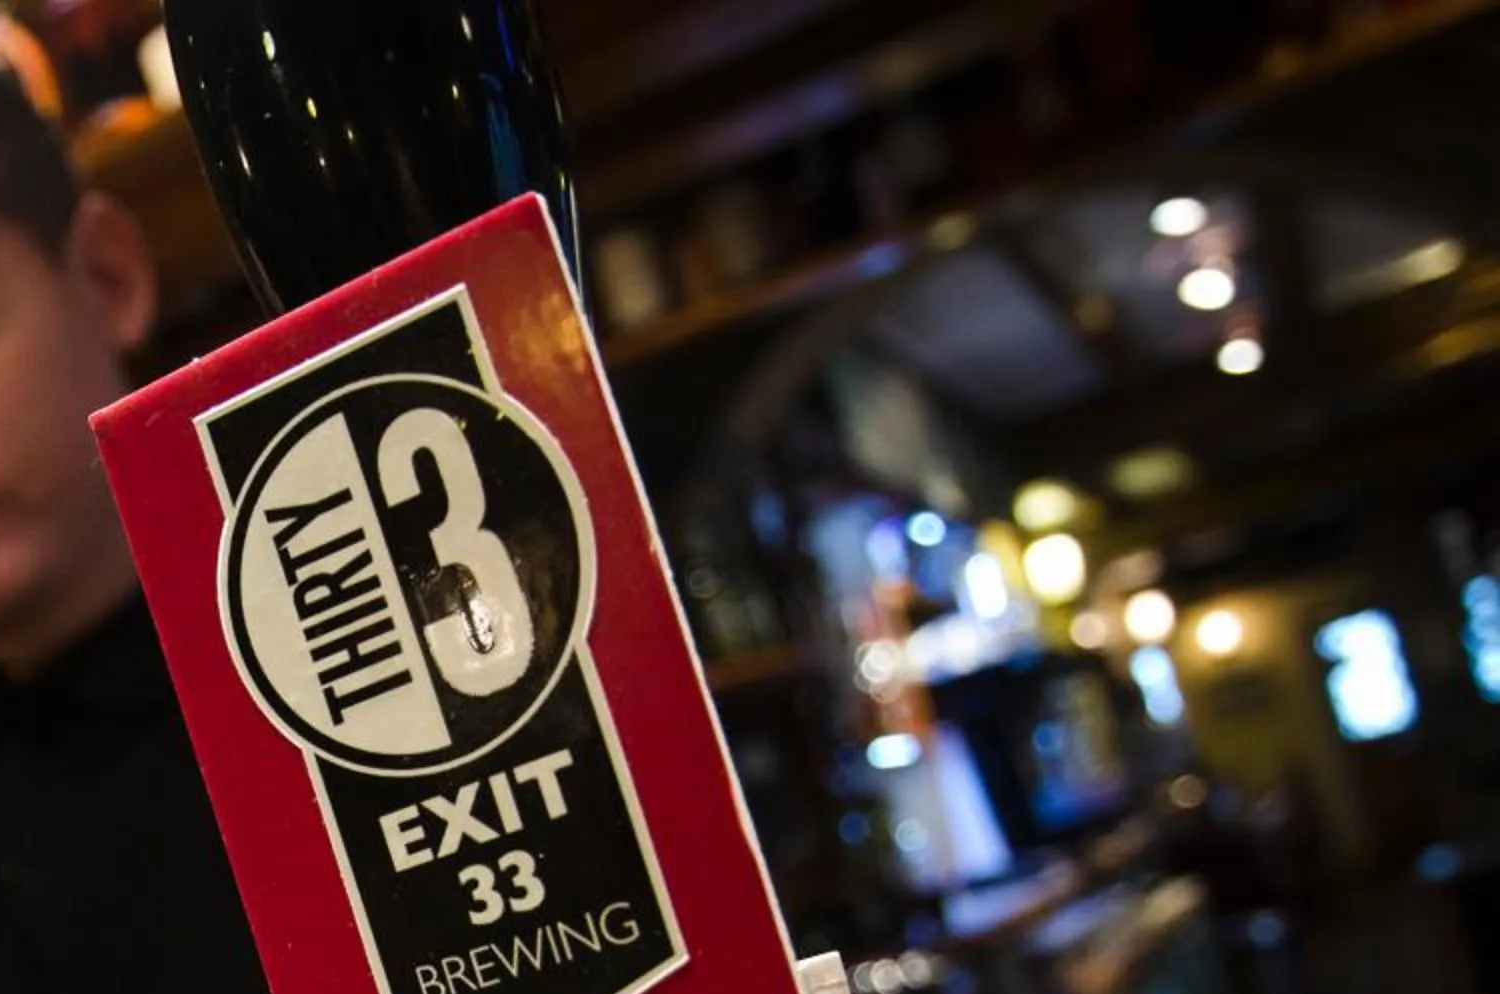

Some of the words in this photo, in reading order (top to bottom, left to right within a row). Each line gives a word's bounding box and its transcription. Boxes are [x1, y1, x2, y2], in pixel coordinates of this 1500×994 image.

[265, 487, 413, 726] THIRTY
[376, 406, 536, 698] 3
[377, 749, 576, 873] EXIT
[457, 850, 548, 926] 33
